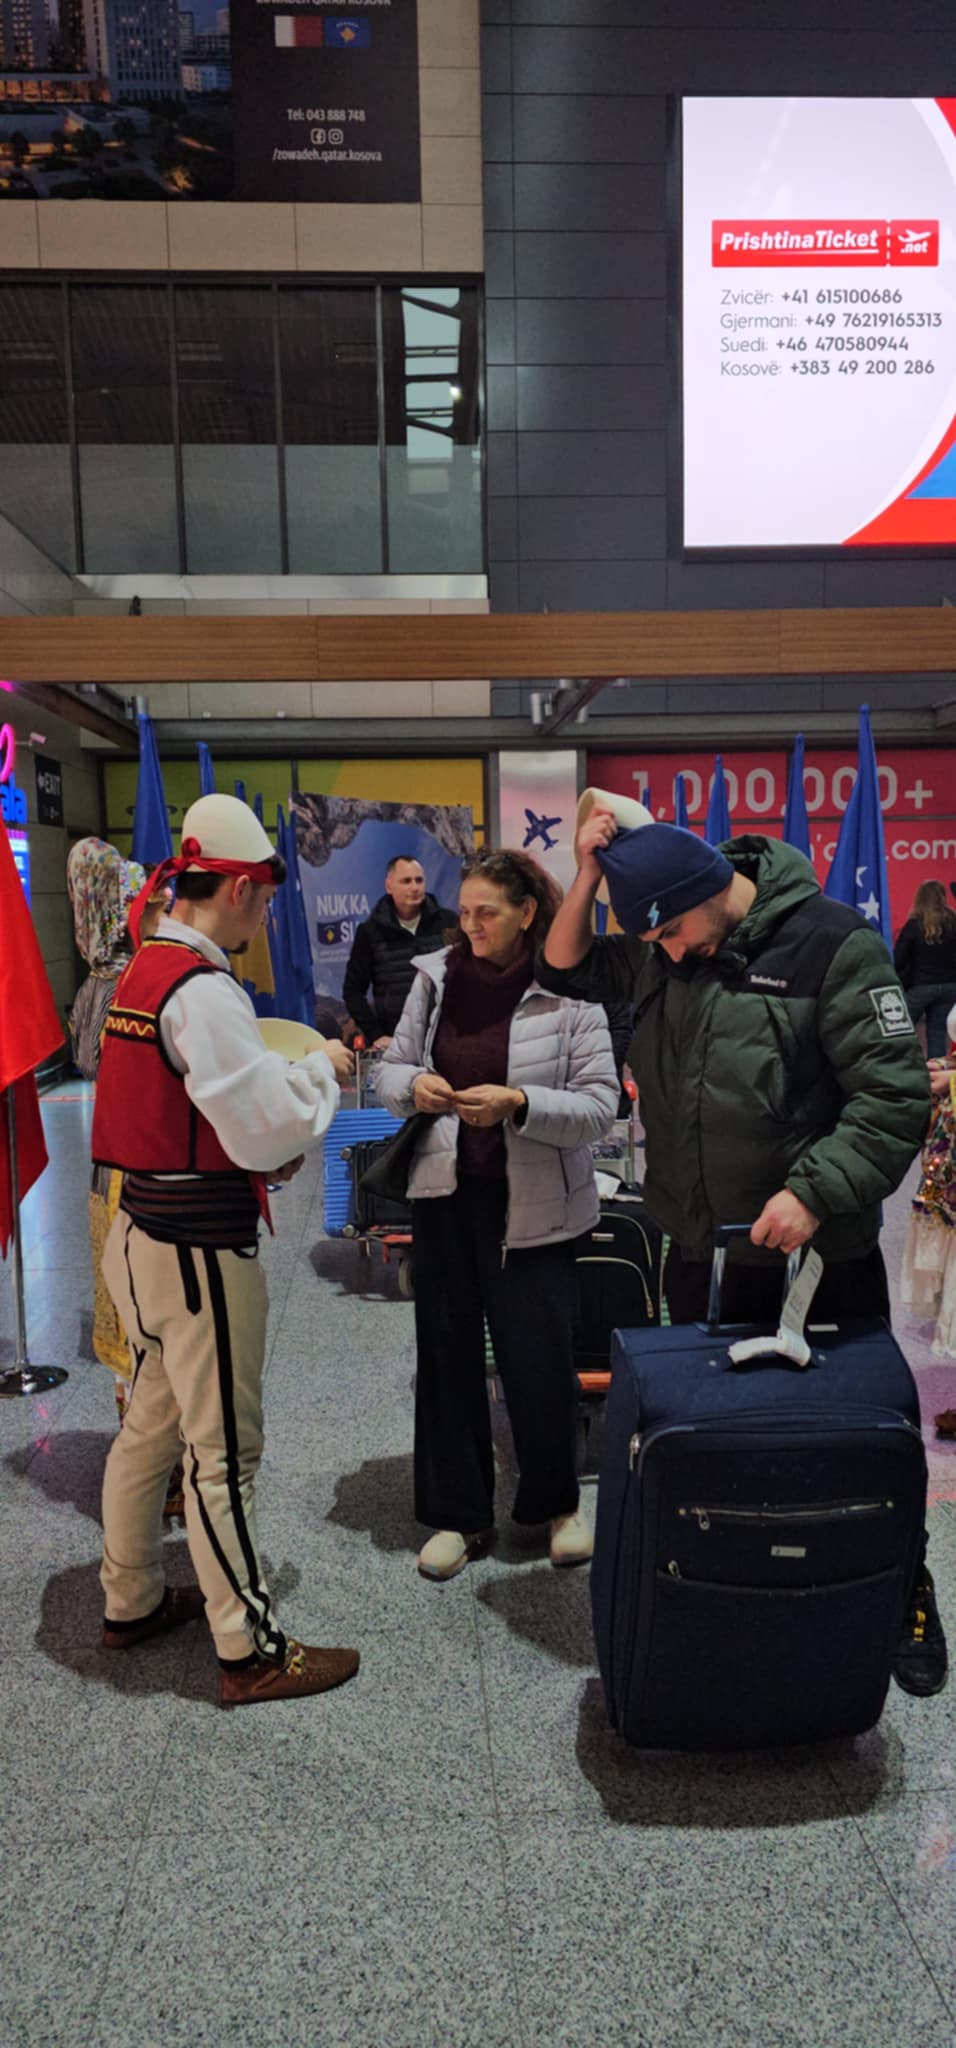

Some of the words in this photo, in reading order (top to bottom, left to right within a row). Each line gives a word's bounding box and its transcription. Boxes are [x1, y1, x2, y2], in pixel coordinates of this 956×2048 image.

[287, 109, 304, 121] Tel:
[306, 109, 325, 121] 043
[327, 109, 345, 121] 888
[348, 110, 366, 122] 748
[720, 229, 878, 251] PrishtinaTicket
[900, 241, 928, 254] .net
[720, 289, 773, 305] Zvicër:
[781, 289, 808, 304] +41
[816, 289, 902, 304] 615100686
[720, 313, 797, 332] Gjermani:
[805, 313, 836, 328] +49
[843, 312, 942, 328] 76219165313
[720, 337, 768, 352] Suedi:
[776, 336, 807, 352] +46
[815, 336, 909, 351] 470580944
[720, 361, 781, 376] Kosovë:
[789, 360, 830, 375] +383
[838, 360, 858, 375] 49
[866, 360, 897, 375] 200
[904, 360, 935, 375] 286
[317, 895, 349, 916] NUK
[350, 894, 370, 915] KA
